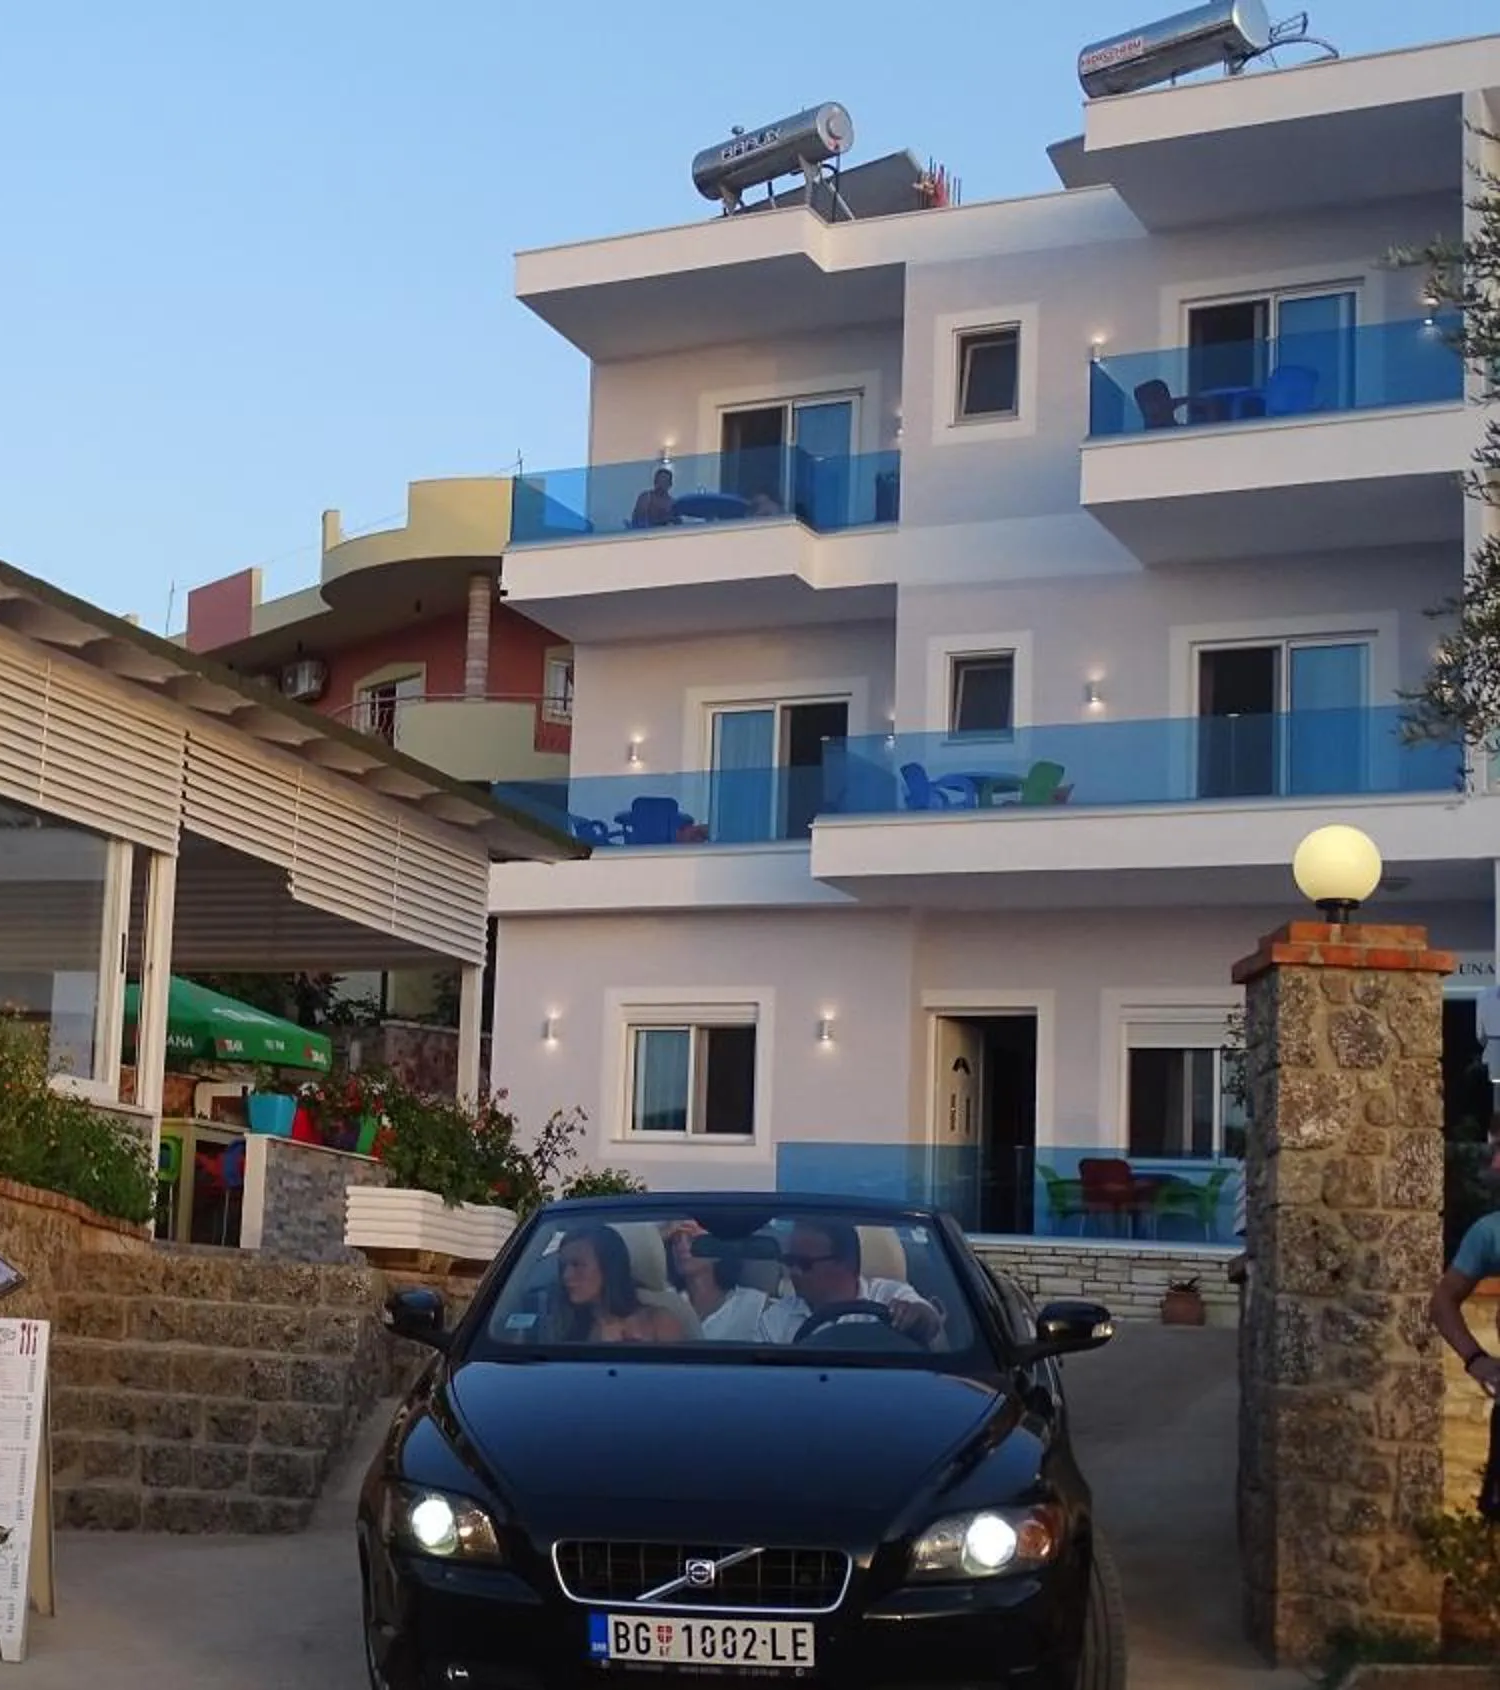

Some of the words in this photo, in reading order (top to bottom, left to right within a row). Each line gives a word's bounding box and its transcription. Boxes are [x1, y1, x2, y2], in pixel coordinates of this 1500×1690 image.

[1458, 963, 1496, 975] UNA
[167, 1035, 194, 1049] ANA
[613, 1620, 651, 1655] BG
